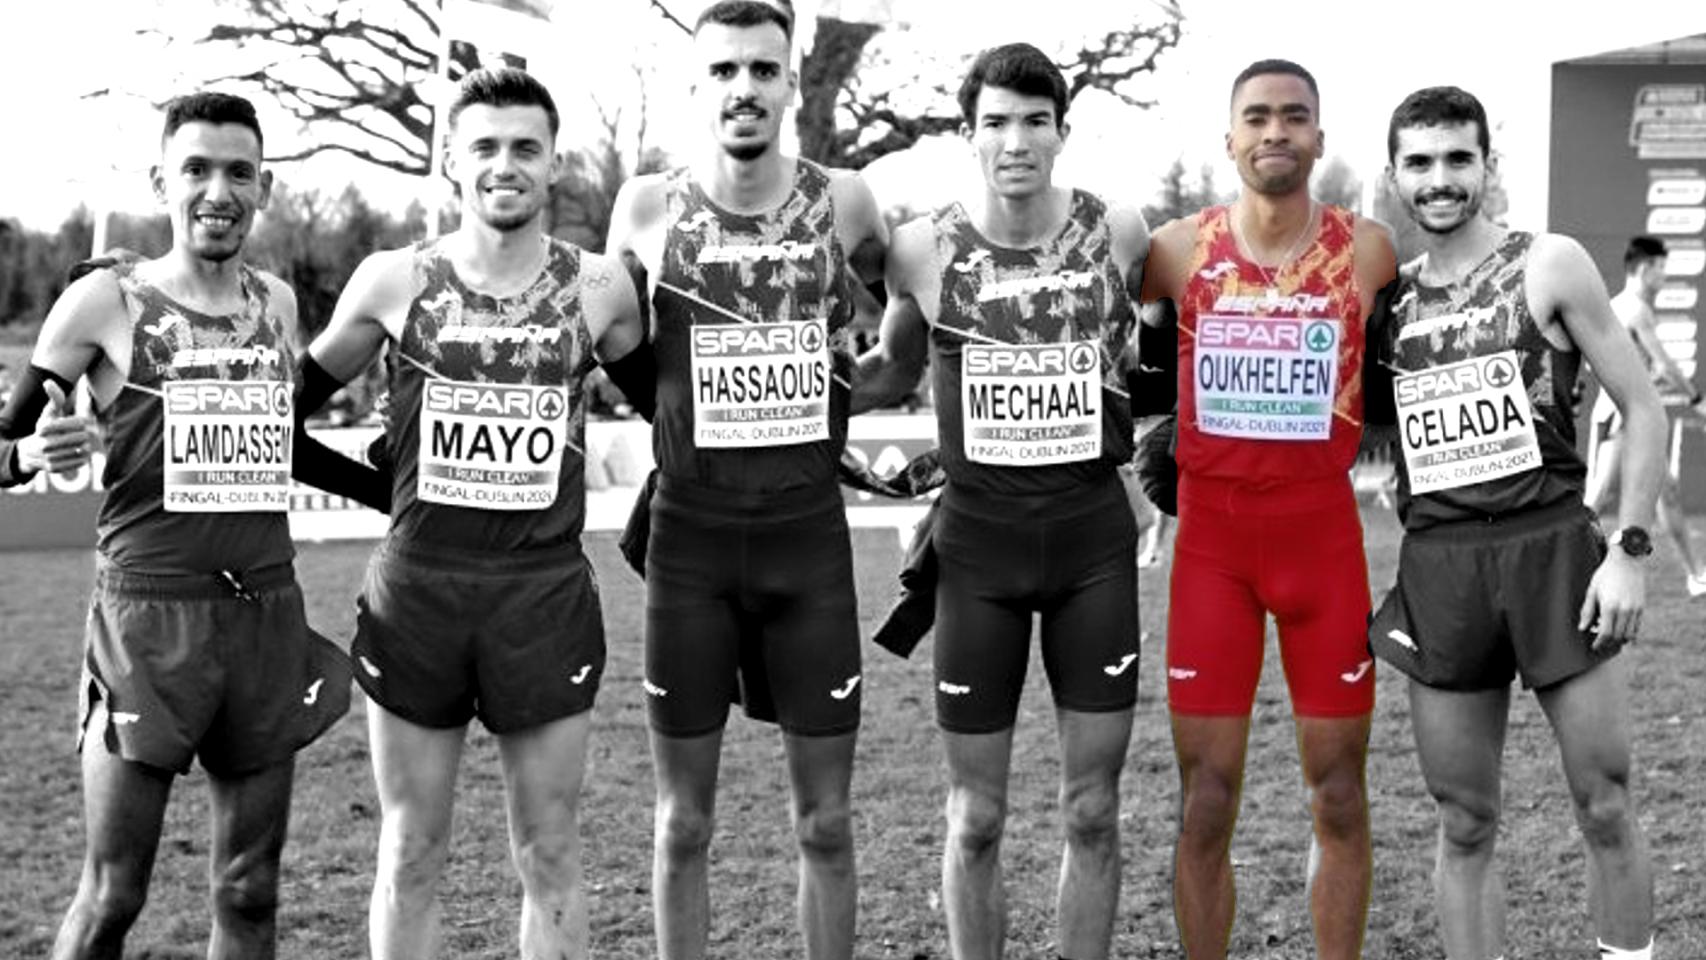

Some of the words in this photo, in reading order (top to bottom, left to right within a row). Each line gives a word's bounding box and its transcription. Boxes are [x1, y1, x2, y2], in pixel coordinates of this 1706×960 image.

[695, 328, 794, 353] SPAR
[1202, 323, 1298, 347] SPAR
[967, 350, 1064, 373] SPAR
[1198, 354, 1331, 395] OUKHELFEN
[169, 387, 268, 411] SPAR
[427, 387, 530, 415] SPAR
[698, 361, 826, 404] HASSAOUS
[968, 381, 1096, 421] MECHAAL
[1398, 366, 1480, 405] SPAR
[1406, 394, 1525, 449] CELADA
[431, 420, 555, 465] MAYO
